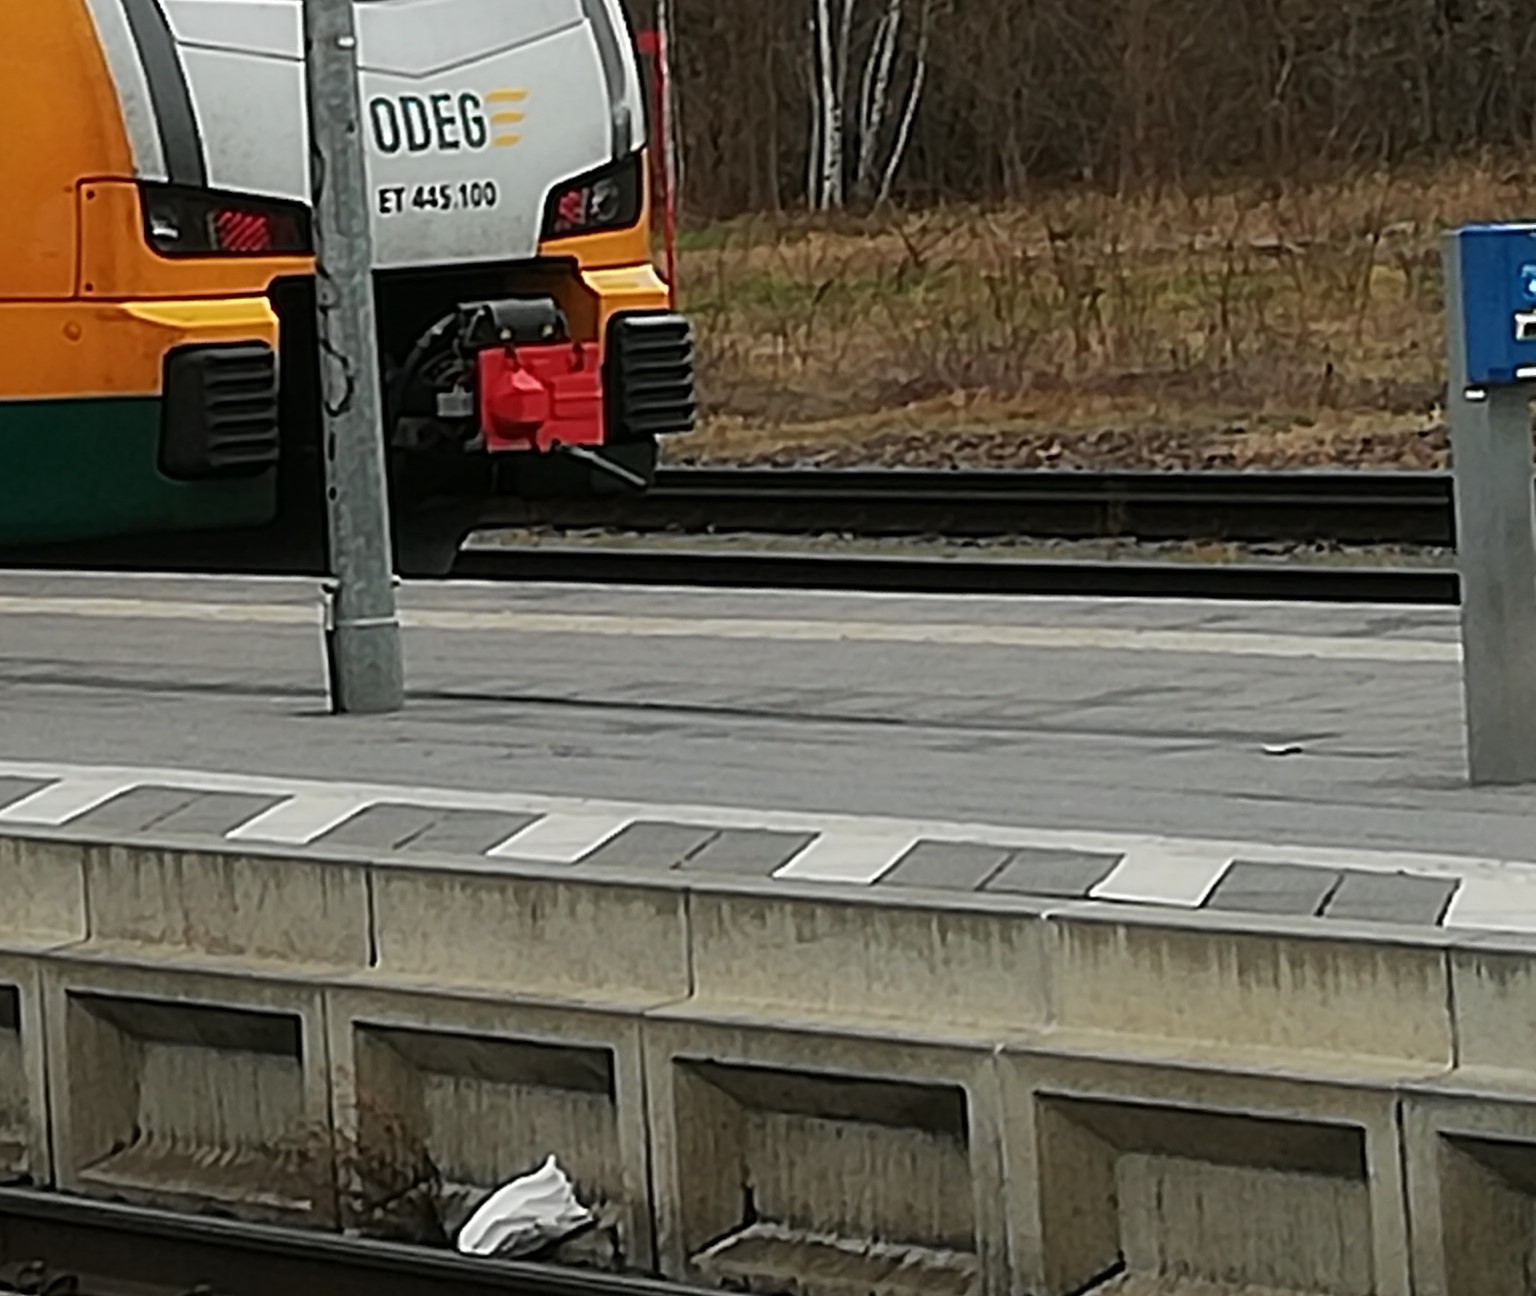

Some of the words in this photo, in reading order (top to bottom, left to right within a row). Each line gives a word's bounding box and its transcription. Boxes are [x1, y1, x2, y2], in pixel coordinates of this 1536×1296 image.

[369, 92, 488, 154] ODEG
[378, 186, 405, 214] ET
[412, 180, 497, 210] 445.100
